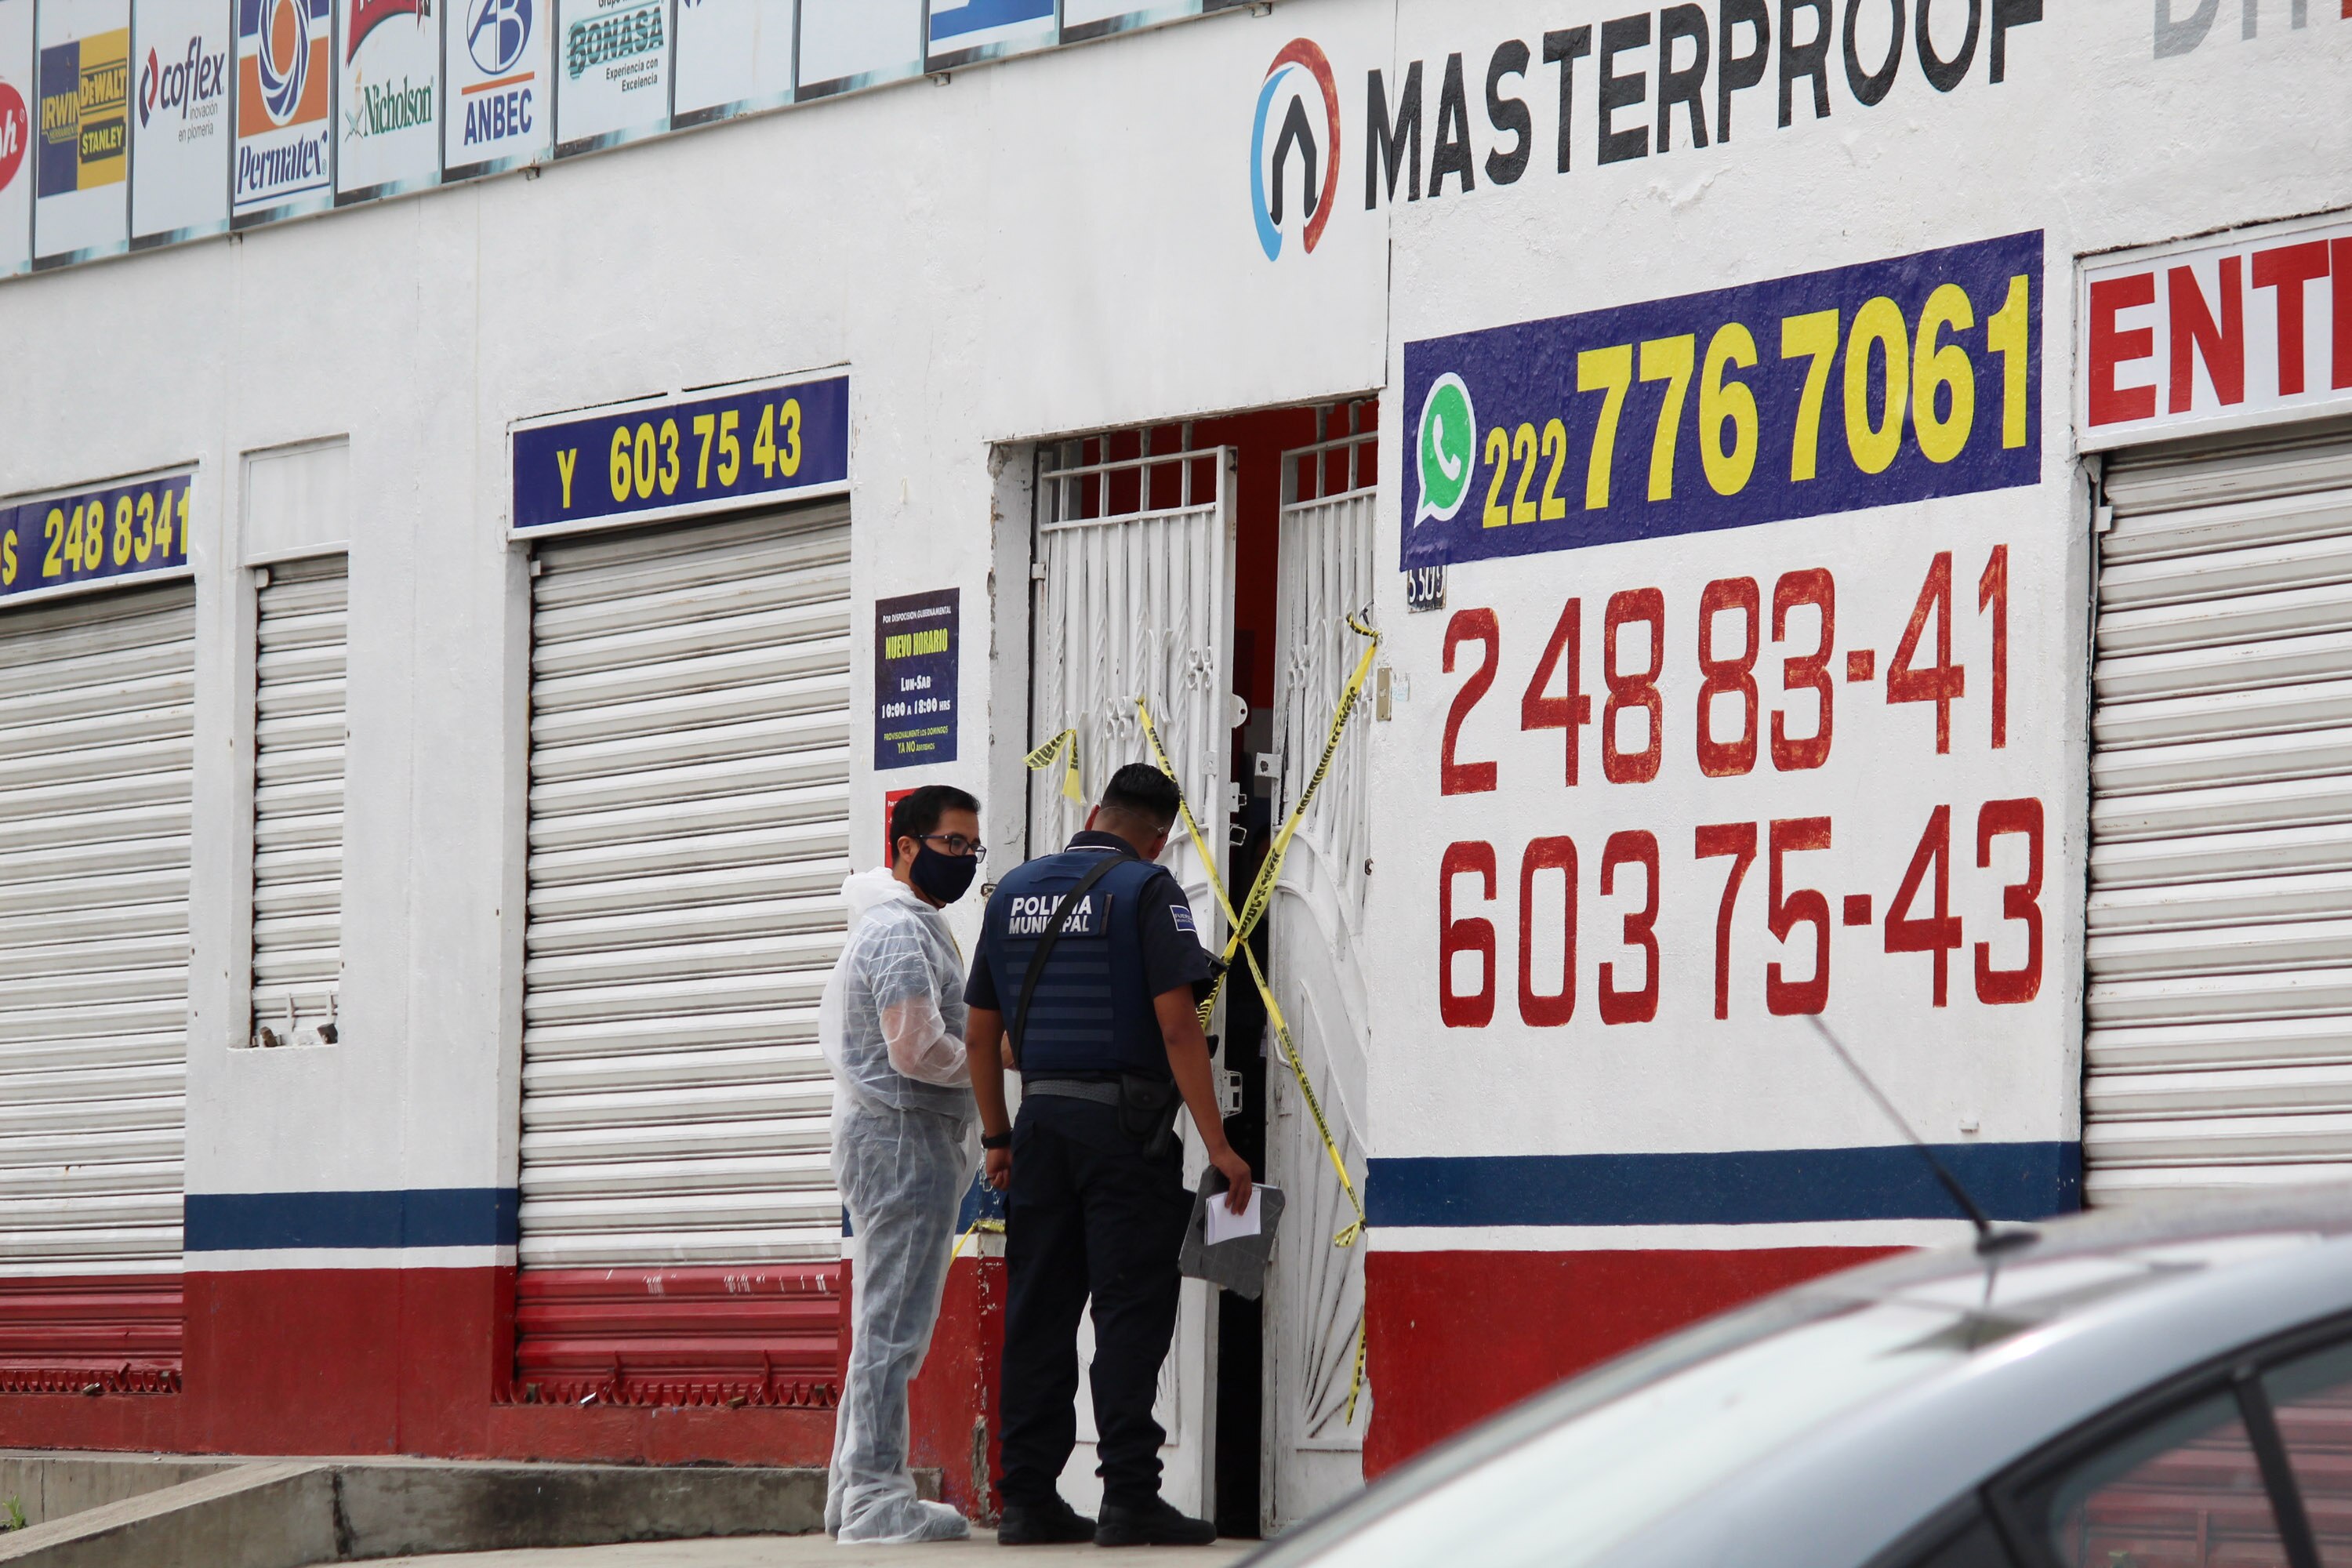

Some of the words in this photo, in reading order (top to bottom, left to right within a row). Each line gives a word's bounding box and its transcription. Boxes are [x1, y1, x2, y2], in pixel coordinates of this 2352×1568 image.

[569, 6, 664, 77] BONASA
[160, 35, 225, 119] coflex
[606, 60, 644, 82] Experiencia
[646, 58, 658, 69] con
[622, 74, 658, 92] Excelencia
[42, 90, 78, 130] IRWIN
[364, 74, 432, 137] Nicholson
[463, 88, 532, 146] ANBEC
[1365, 0, 2042, 209] MASTERPROOF
[82, 125, 123, 155] STANLEY
[179, 129, 186, 142] en
[238, 129, 328, 194] Permatex
[1482, 417, 1566, 528] 222
[1577, 321, 1759, 510] 776
[1781, 274, 2029, 482] 7061
[556, 448, 577, 508] Y
[610, 418, 680, 503] 603
[693, 409, 740, 489] 75
[753, 398, 801, 479] 43
[42, 500, 104, 577] 248
[113, 486, 191, 566] 8341
[917, 606, 951, 619] GUBERNAMENTAL
[885, 633, 912, 659] NUEVO
[913, 628, 948, 656] HORARIO
[1441, 586, 1665, 796] 248
[1697, 543, 2009, 778] 83-41
[882, 702, 906, 719] 10:00
[906, 705, 912, 715] A
[914, 697, 938, 714] 18:00
[938, 699, 950, 711] HRS
[927, 725, 949, 735] DOMINGOS
[897, 742, 905, 753] YA
[906, 740, 916, 753] NO
[1009, 915, 1090, 934] MUNIPAL
[1439, 829, 1660, 1028] 603
[1694, 797, 2045, 1020] 75-43
